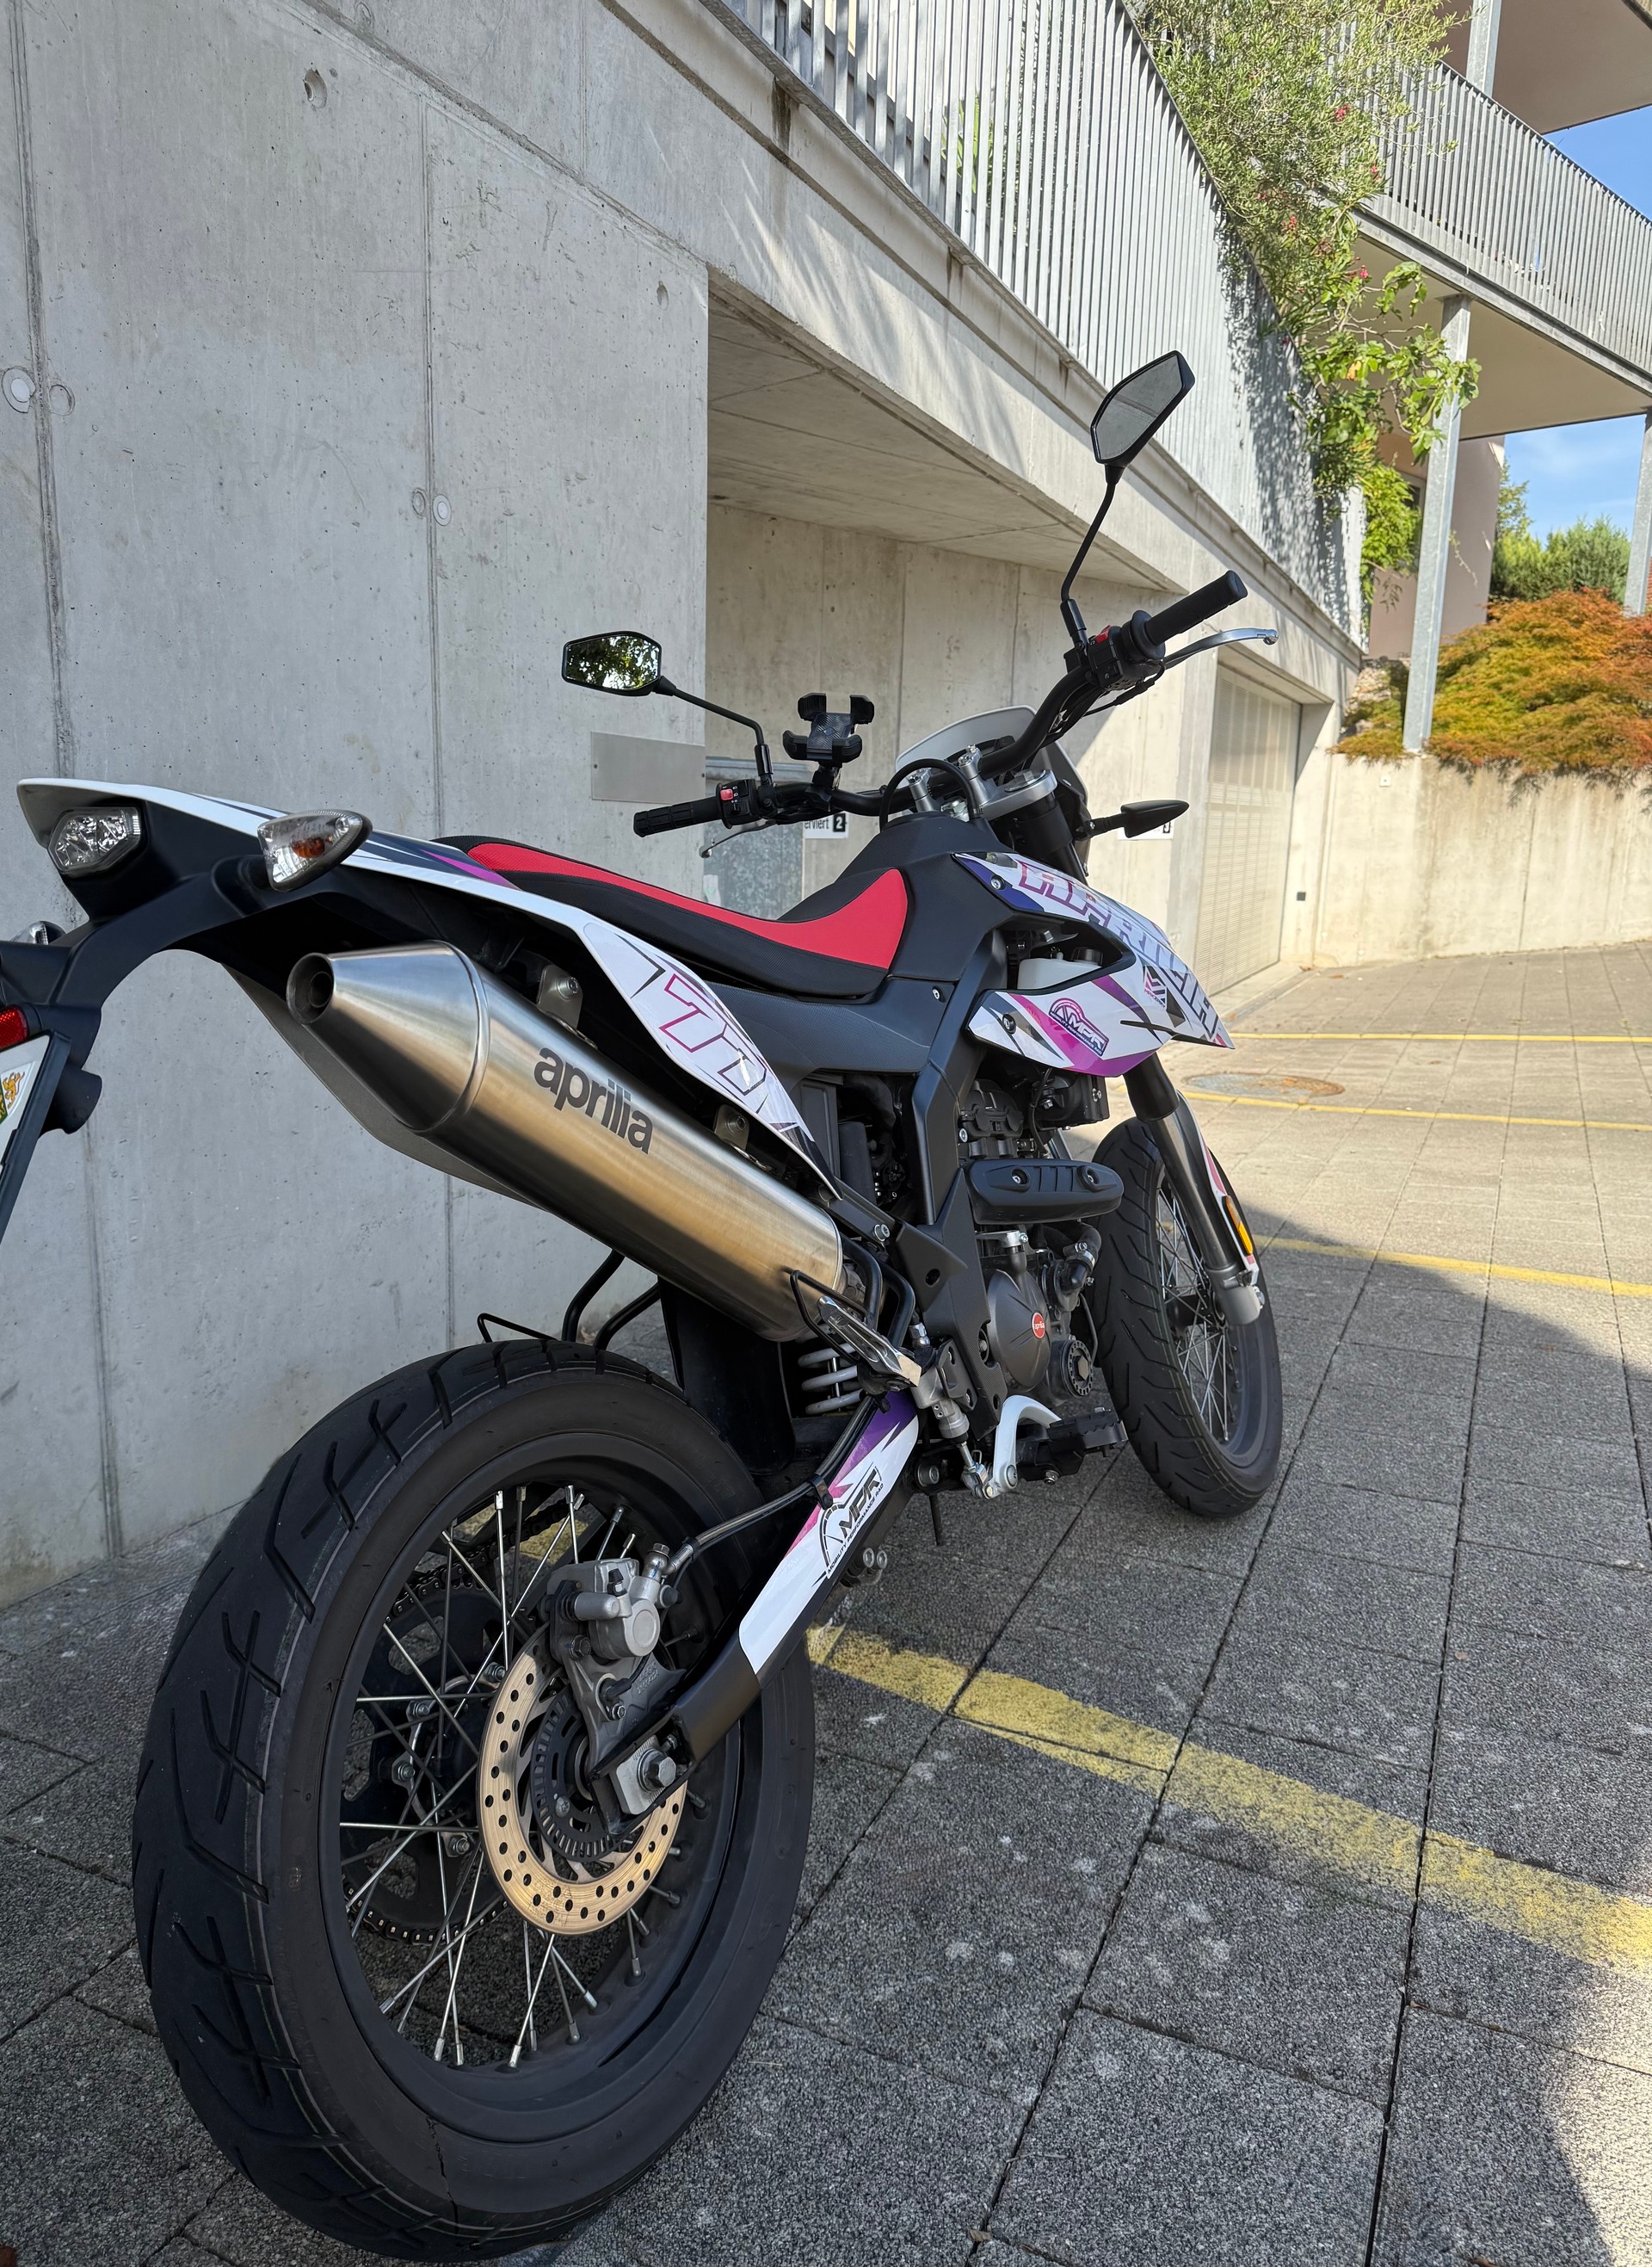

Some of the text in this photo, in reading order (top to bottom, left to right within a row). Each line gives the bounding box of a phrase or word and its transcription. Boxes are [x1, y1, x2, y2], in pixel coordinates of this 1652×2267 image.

[835, 816, 843, 830] 2
[533, 1047, 654, 1155] aprilia
[827, 1483, 885, 1574] MOBILITY PERFORMANCE RAD
